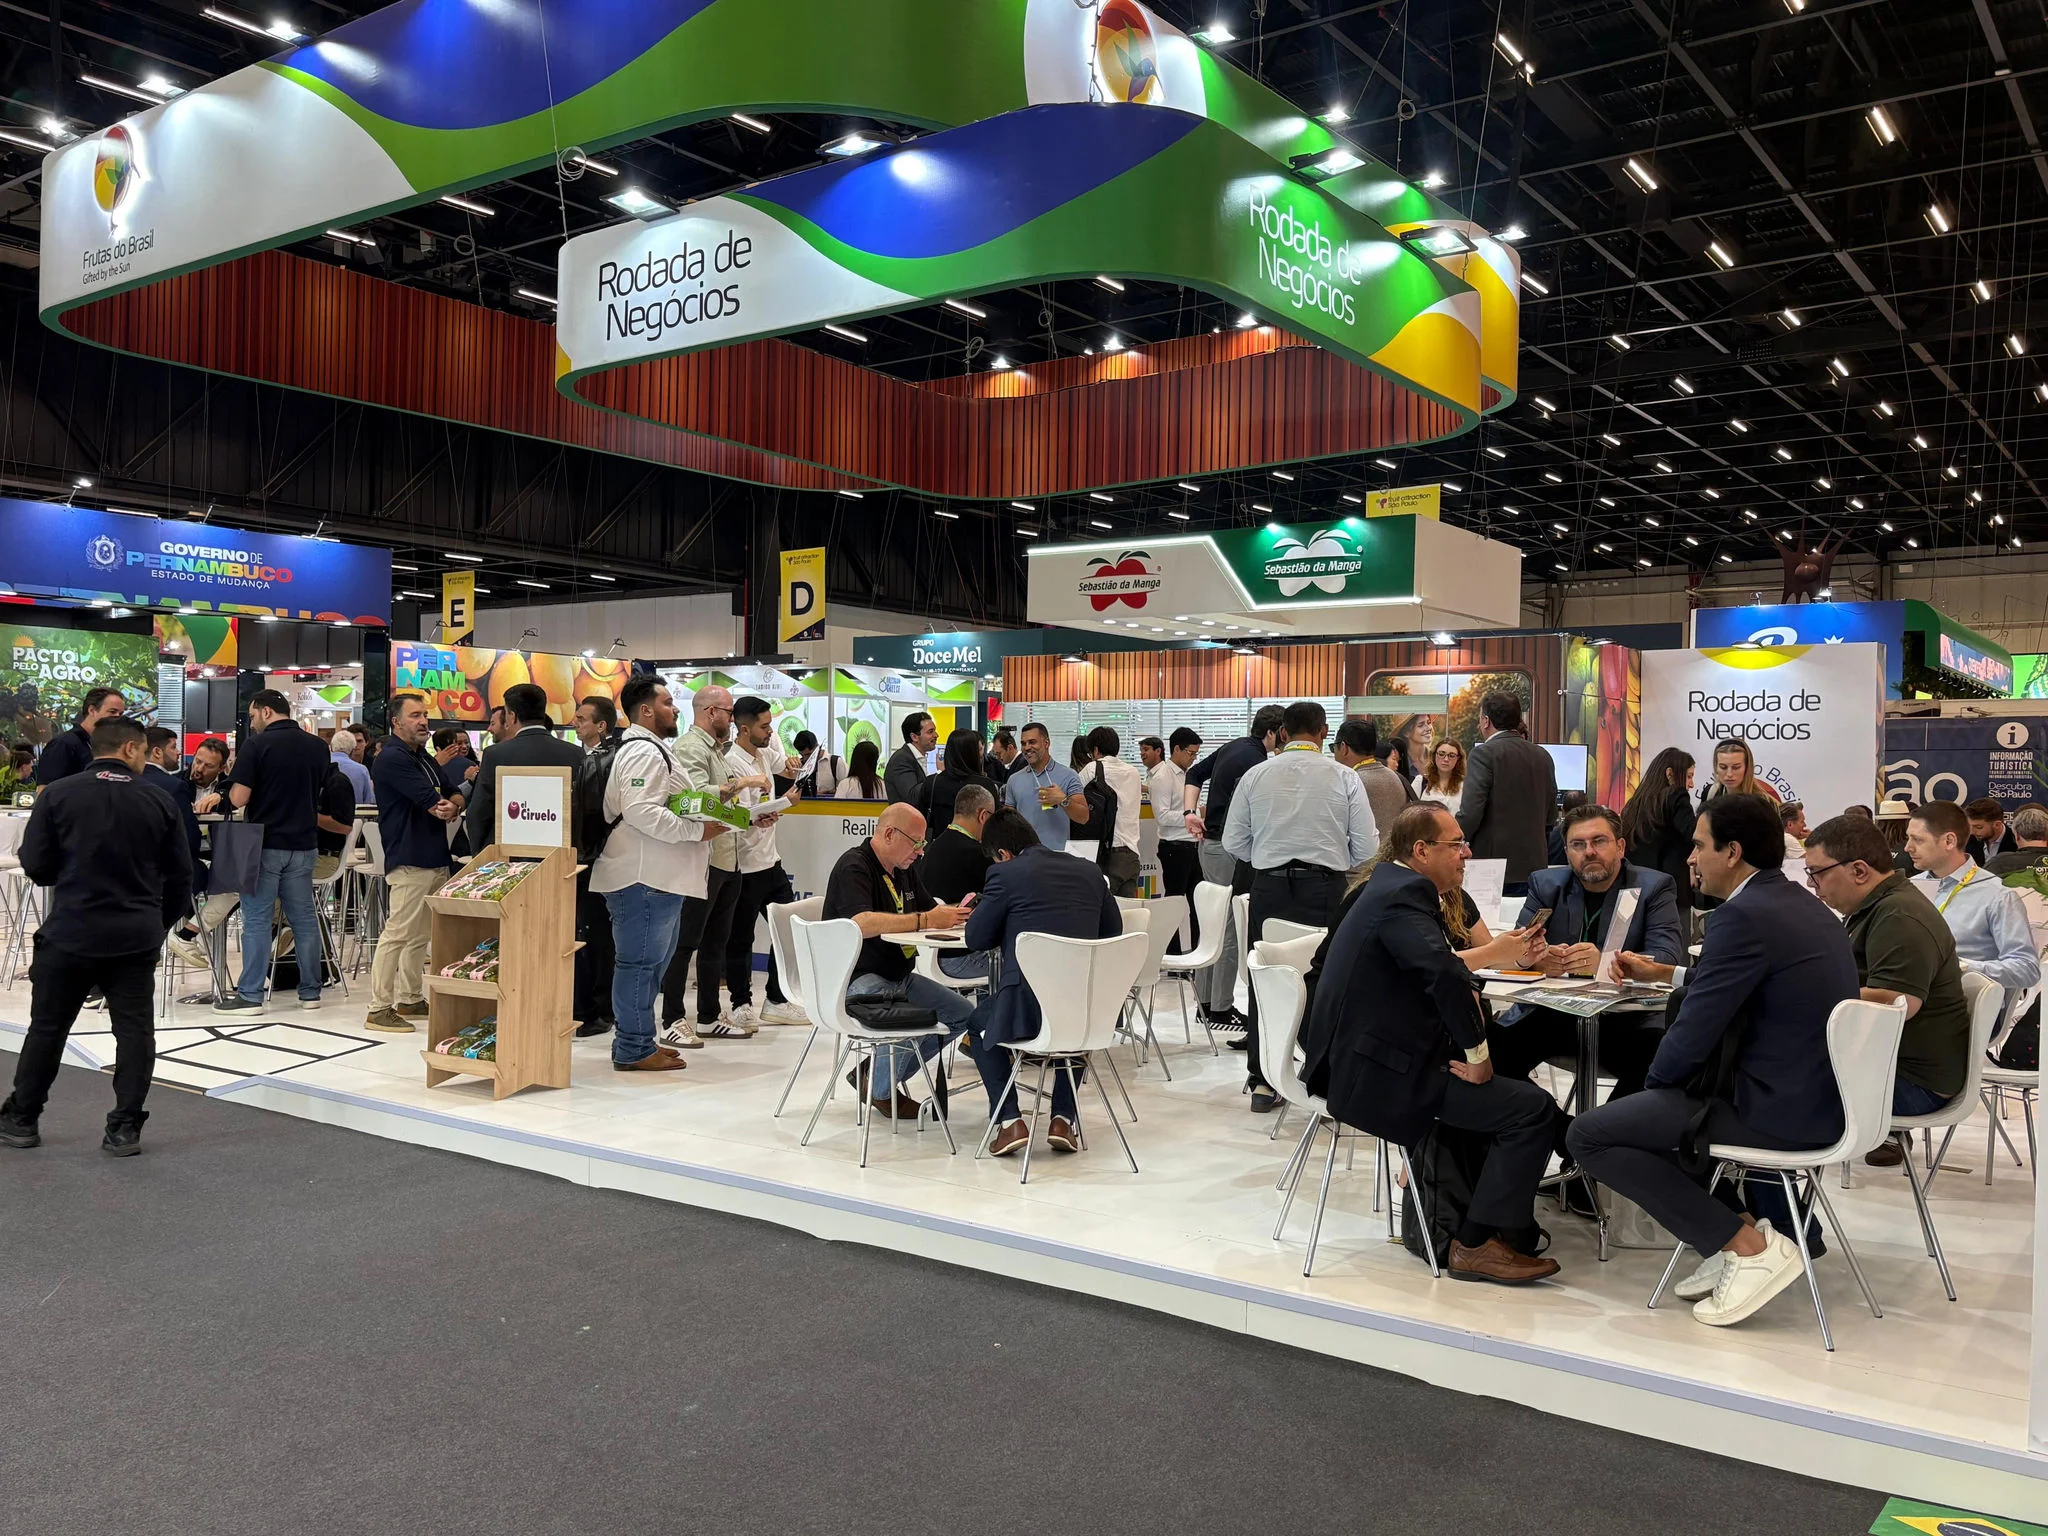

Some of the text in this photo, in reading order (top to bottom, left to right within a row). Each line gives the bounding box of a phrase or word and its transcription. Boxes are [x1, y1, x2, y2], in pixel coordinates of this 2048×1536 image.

[1250, 183, 1361, 285] Rodada de
[83, 229, 154, 269] Frutas do Brasil
[82, 262, 131, 284] Gifted by the Sun
[599, 230, 752, 301] Rodada de
[1259, 236, 1355, 325] Negócios
[607, 281, 741, 341] Negócios
[160, 542, 263, 565] GOVERNO DE
[126, 551, 293, 583] PERNAMBUCO
[1264, 560, 1362, 575] Sebastião da Manga
[151, 570, 271, 589] ESTADO DE MUDANÇA
[1078, 579, 1160, 592] Sebastião da Manga
[791, 582, 814, 616] D
[451, 599, 465, 628] E
[912, 639, 934, 647] GRUPO
[13, 647, 76, 664] PACTO
[397, 648, 458, 671] PER
[13, 662, 97, 683] PELO AGRO
[396, 667, 466, 691] NAM
[1688, 689, 1821, 712] Rodada de
[1697, 717, 1811, 740] Negócios
[1989, 751, 2033, 761] INFORMAÇÃO
[1989, 760, 2033, 770] TURÍSTICA
[1766, 767, 1801, 803] Brasi
[1988, 782, 2032, 790] Descubra
[1988, 789, 2032, 798] São Paulo
[521, 808, 556, 821] Ciruelo
[842, 819, 877, 836] Reali
